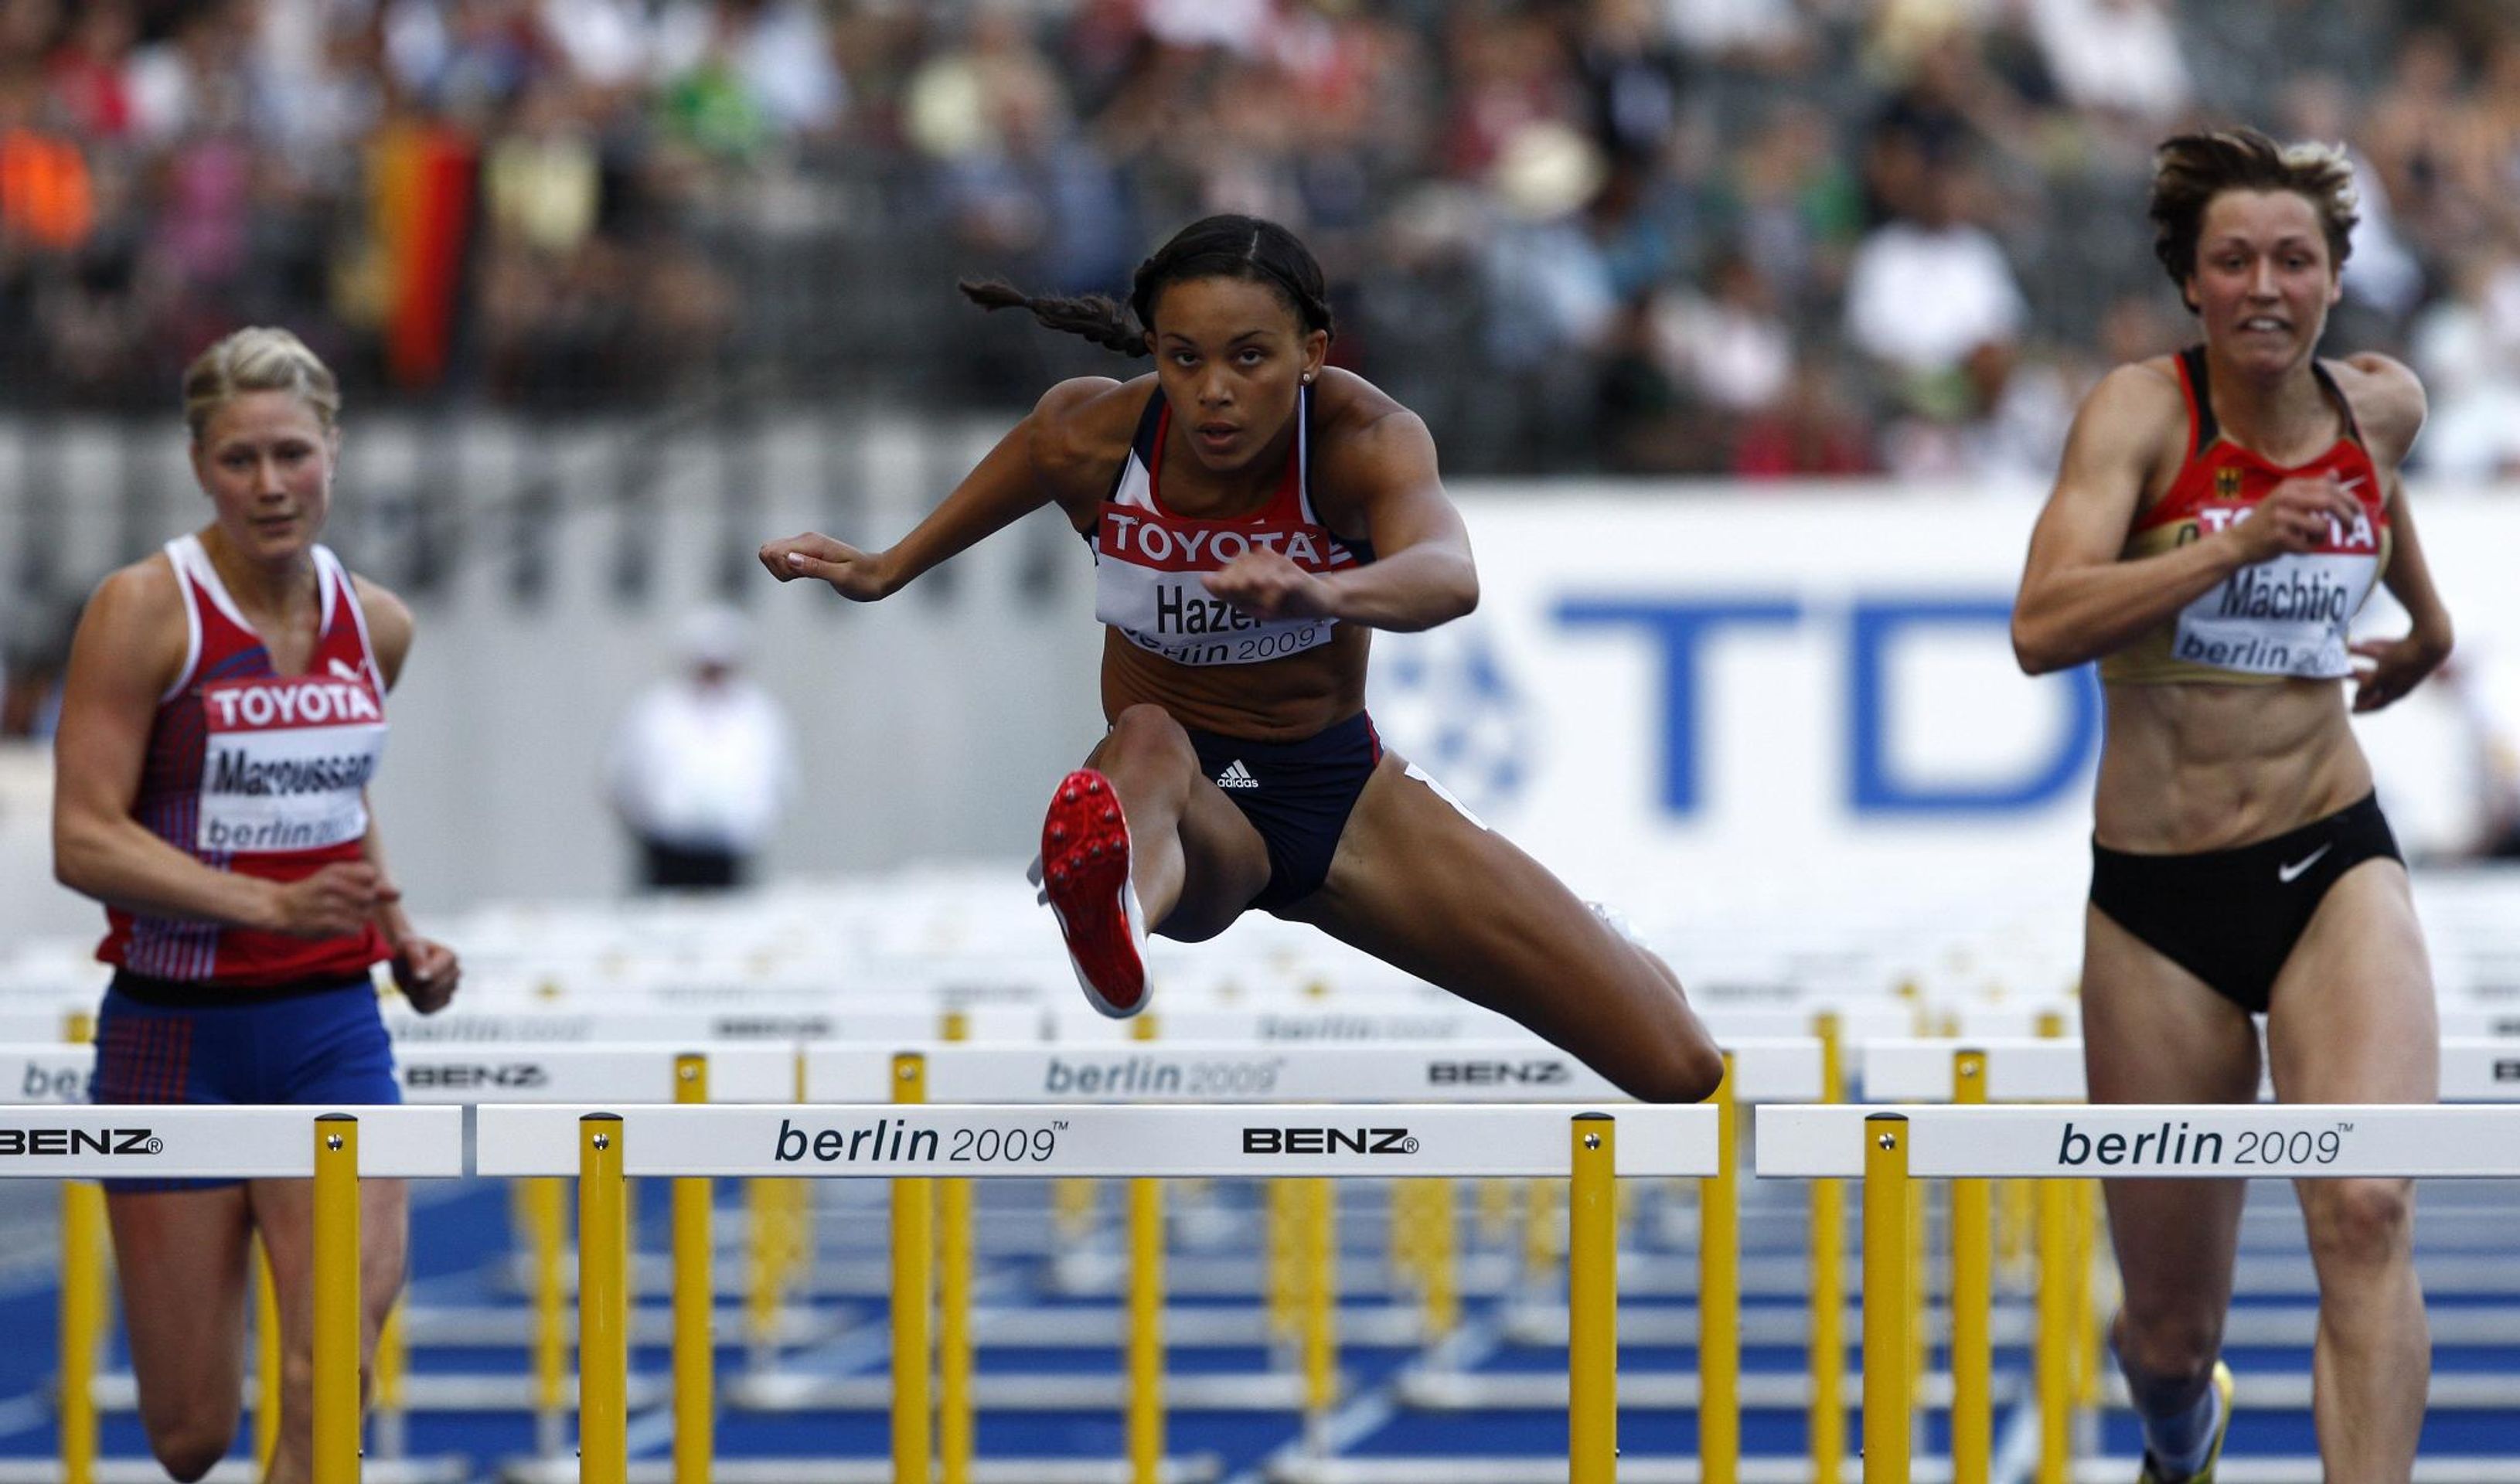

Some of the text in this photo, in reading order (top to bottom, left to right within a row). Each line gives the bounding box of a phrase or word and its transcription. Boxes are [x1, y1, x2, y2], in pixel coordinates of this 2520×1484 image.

[1107, 512, 1322, 564] TOYOTA
[2202, 506, 2375, 548] TTA
[1156, 584, 1262, 635] Haze
[1238, 628, 1315, 659] 2009
[2181, 633, 2290, 668] berlin
[212, 683, 380, 726] TOYOTA
[1217, 776, 1258, 788] adidas
[208, 816, 312, 846] berlin
[1045, 1056, 1183, 1094] berlin
[1427, 1061, 1571, 1085] BENZ
[775, 1120, 939, 1162] berlin
[2058, 1123, 2223, 1166] berlin
